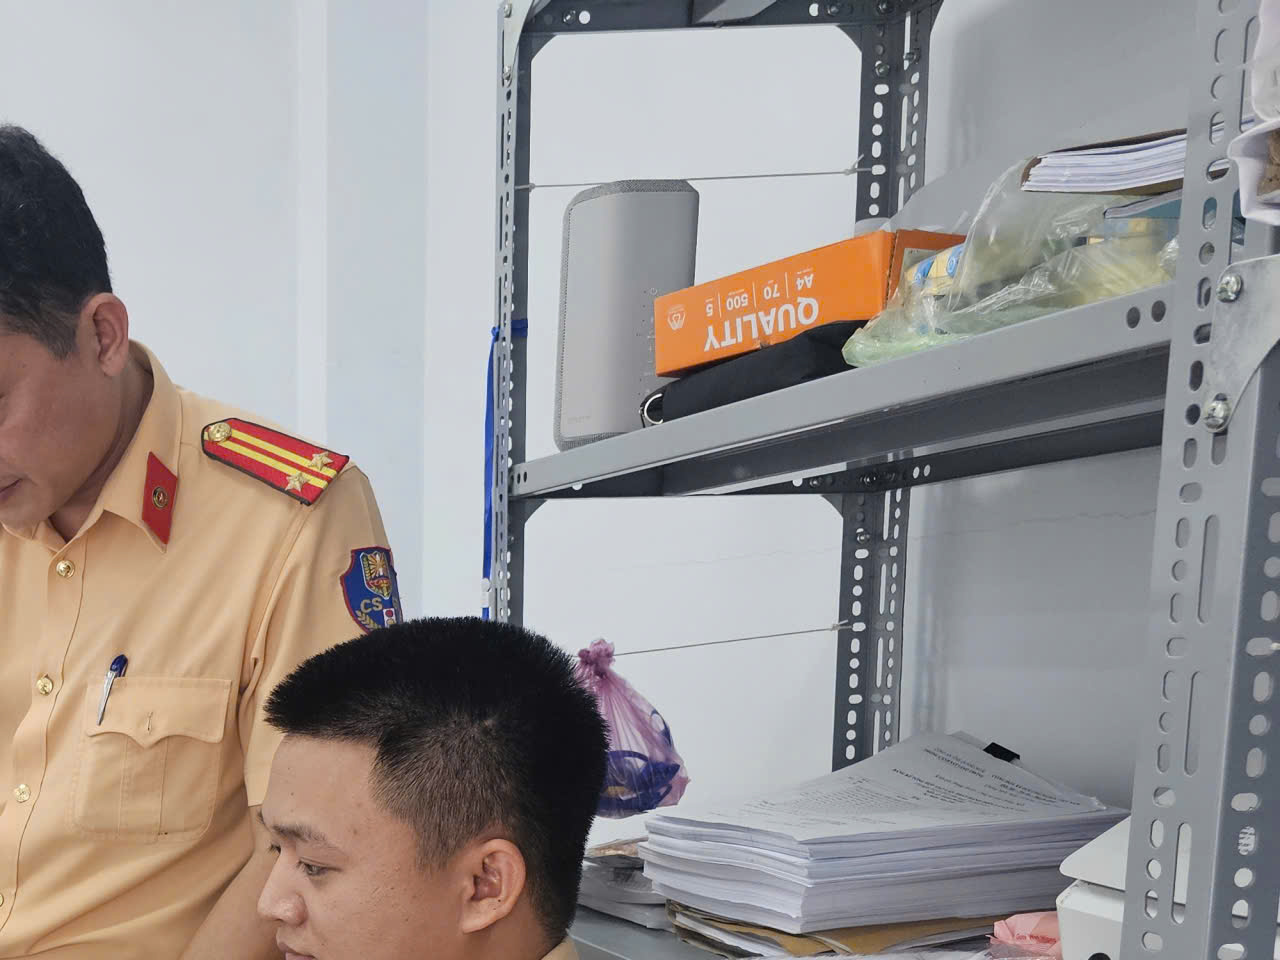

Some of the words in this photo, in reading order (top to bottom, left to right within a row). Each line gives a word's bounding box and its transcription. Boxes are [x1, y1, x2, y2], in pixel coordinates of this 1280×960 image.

[796, 273, 814, 290] A4
[763, 284, 780, 300] 70
[706, 302, 714, 317] 5
[726, 293, 748, 311] 500
[704, 297, 819, 352] QUALITY
[361, 597, 384, 613] CS
